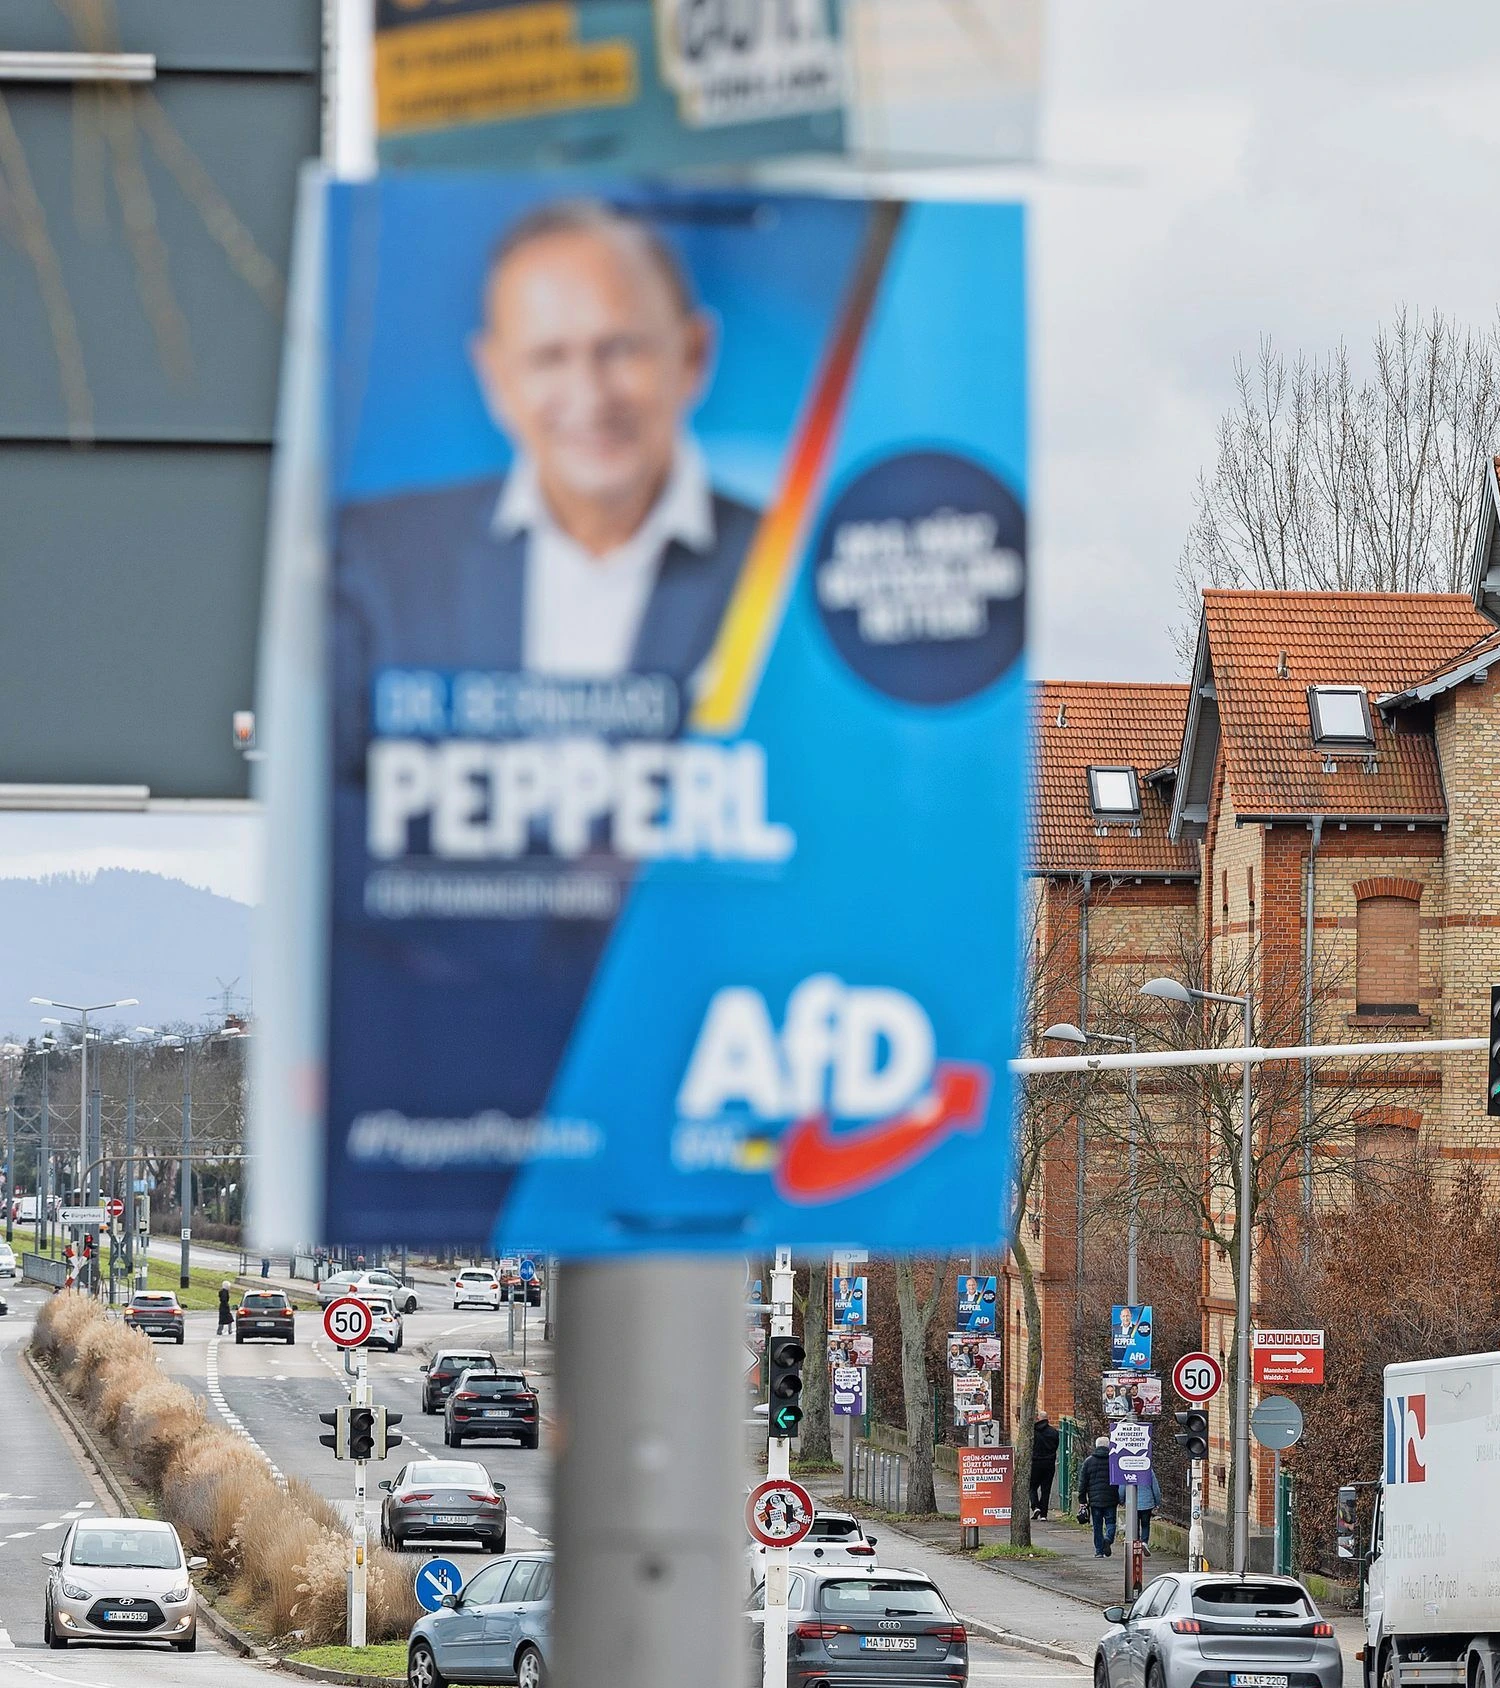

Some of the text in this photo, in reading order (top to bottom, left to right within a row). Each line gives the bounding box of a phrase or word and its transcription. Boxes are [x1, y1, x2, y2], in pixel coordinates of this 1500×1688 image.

[367, 738, 797, 862] PEPPERL
[677, 972, 937, 1122] AfD
[336, 1311, 362, 1333] 50
[975, 1316, 990, 1324] AfD
[1258, 1334, 1320, 1345] BAUHAUS
[1130, 1353, 1145, 1361] AfD
[1185, 1368, 1211, 1389] 50
[866, 1638, 915, 1648] MA DV 755
[1237, 1676, 1288, 1685] KA KF 2202
